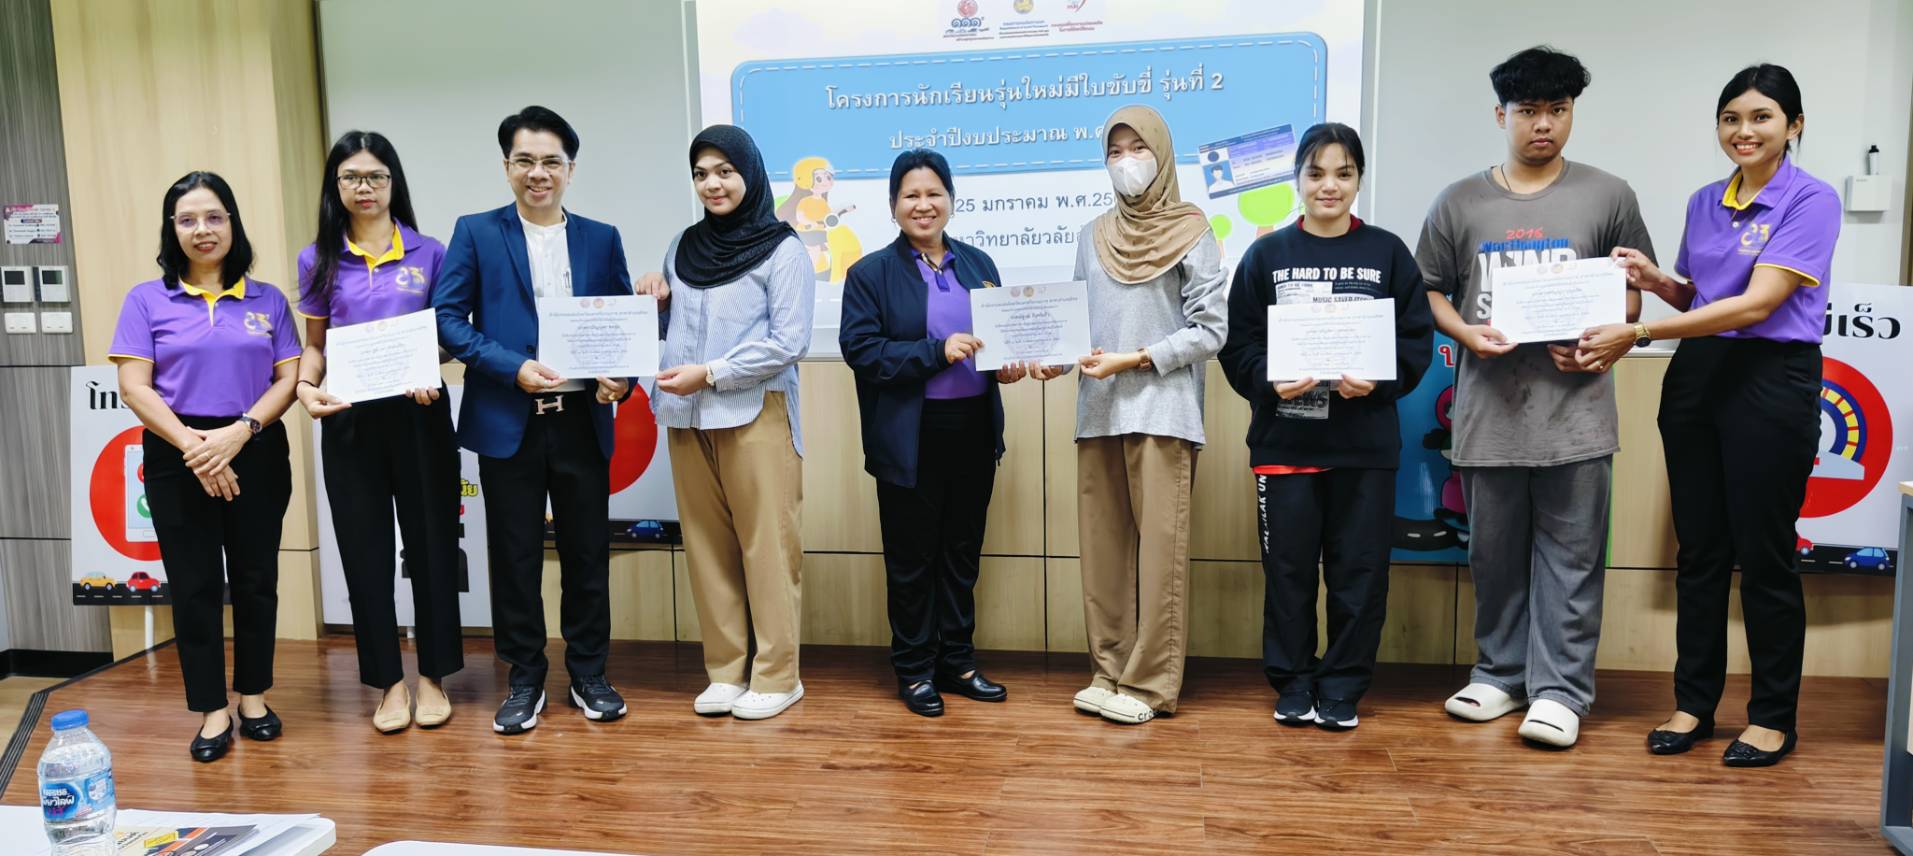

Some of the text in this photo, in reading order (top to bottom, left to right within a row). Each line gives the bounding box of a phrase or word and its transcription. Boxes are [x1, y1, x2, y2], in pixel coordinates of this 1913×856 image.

[825, 63, 1225, 111] โครงการนักเรียนรุ่นใหม่มีใบขับขี่ รุ่นที่ 2
[889, 126, 1068, 150] ประจำปีงบประมาณ
[982, 197, 1049, 212] มกราคม
[1055, 192, 1116, 208] พ.ศ.25
[1272, 267, 1382, 284] THE HARD TO BE SURE
[85, 380, 129, 410] โท
